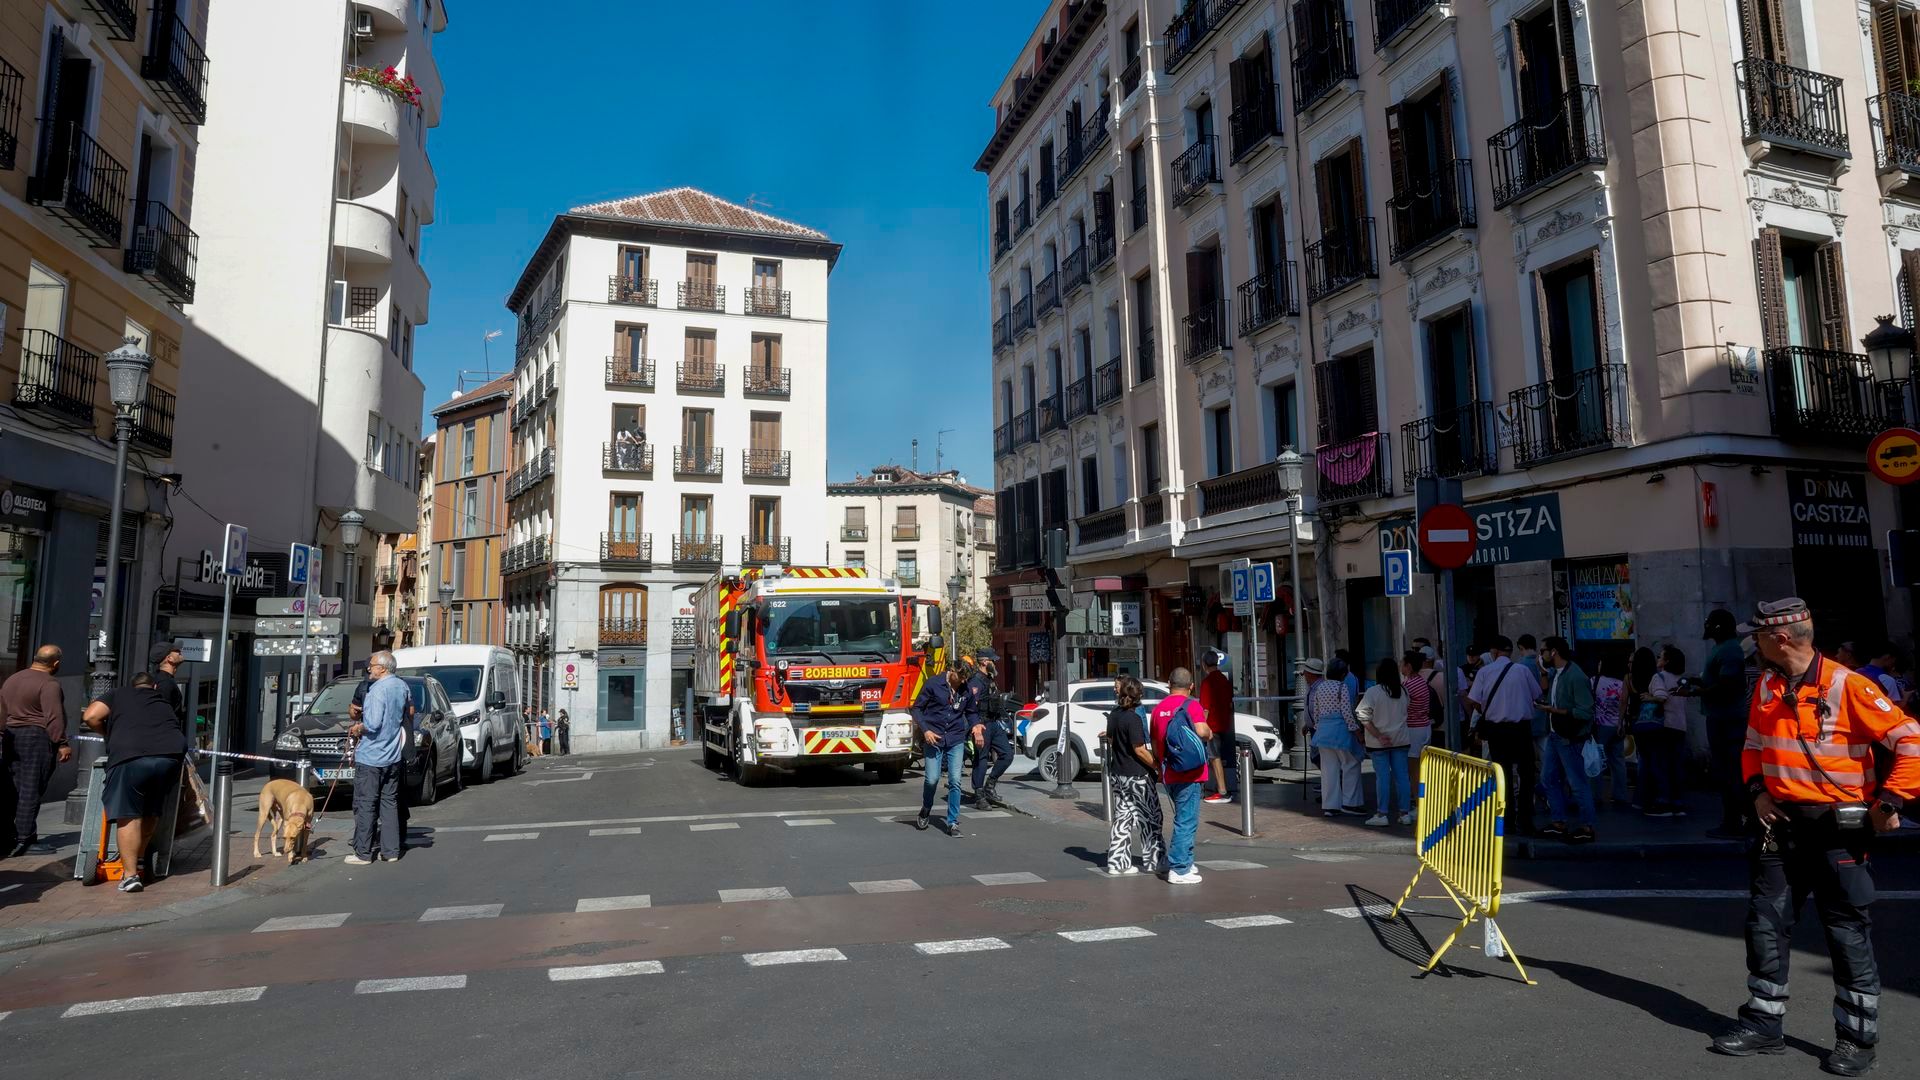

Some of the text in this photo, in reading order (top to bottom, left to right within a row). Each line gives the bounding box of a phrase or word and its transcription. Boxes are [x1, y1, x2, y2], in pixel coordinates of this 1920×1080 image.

[14, 495, 47, 512] OLEOTECA
[1793, 502, 1869, 524] CASTIZA
[1477, 505, 1557, 541] STIZA
[1255, 568, 1268, 599] P
[1388, 557, 1404, 592] P
[861, 690, 882, 699] PB-21
[324, 770, 344, 778] 5731
